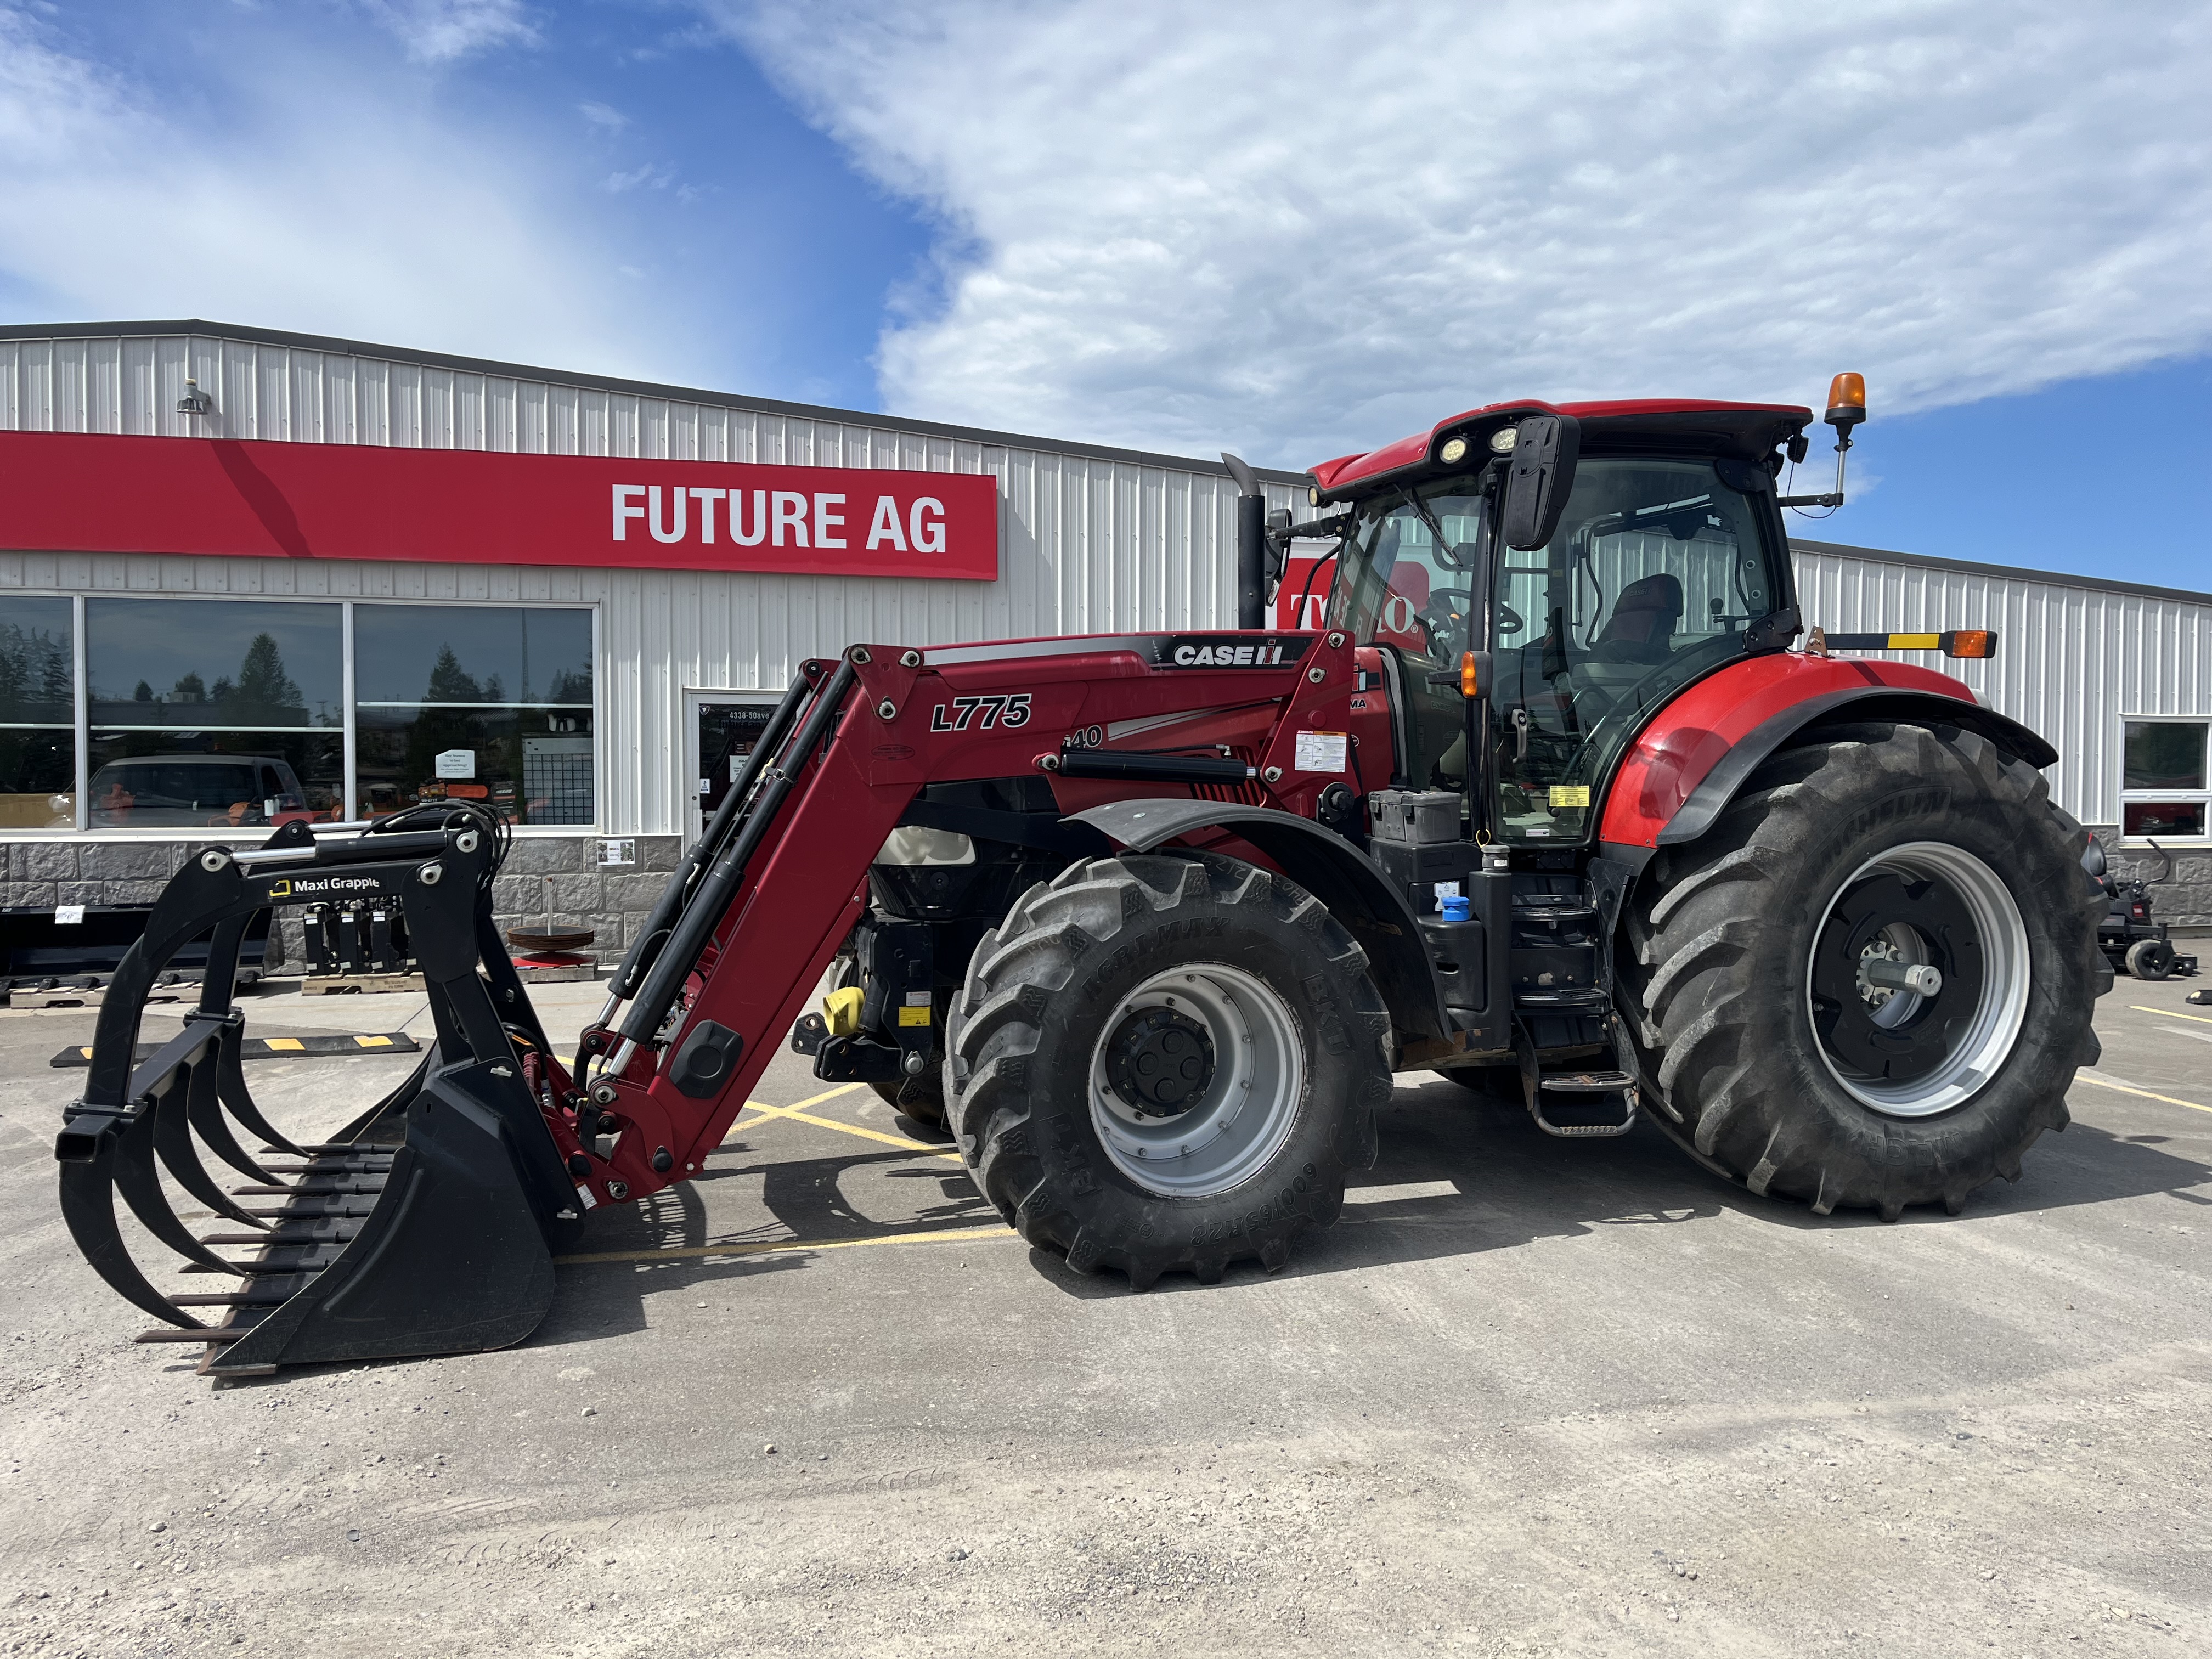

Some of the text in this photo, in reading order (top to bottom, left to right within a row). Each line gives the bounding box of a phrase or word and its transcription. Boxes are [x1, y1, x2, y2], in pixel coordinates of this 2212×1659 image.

[612, 484, 945, 552] FUTURE AG
[1174, 645, 1255, 665] CASE
[930, 693, 1032, 732] L775
[1350, 699, 1367, 709] MA
[1063, 725, 1102, 748] 40
[295, 878, 380, 892] Maxi Grapple
[1302, 973, 1351, 1052] BKT
[1046, 1115, 1099, 1198] BKT
[1190, 1162, 1318, 1247] 600/65R28
